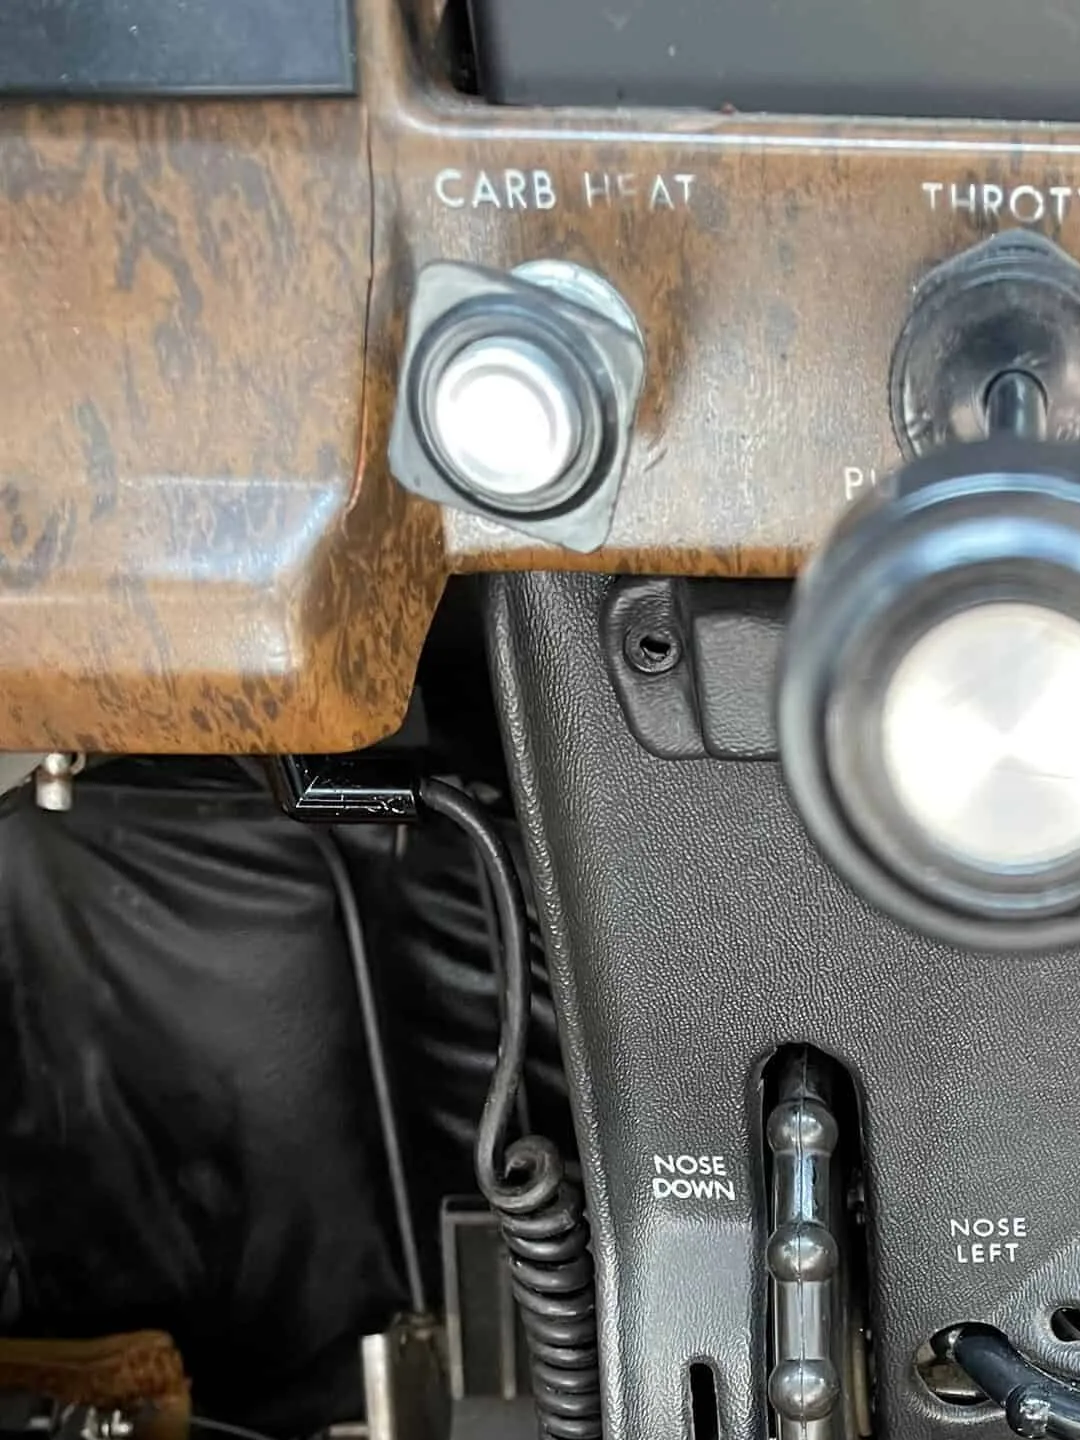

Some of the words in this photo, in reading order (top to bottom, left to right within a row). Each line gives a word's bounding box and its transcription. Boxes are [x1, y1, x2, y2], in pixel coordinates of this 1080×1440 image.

[434, 168, 556, 210] CARB
[584, 171, 697, 211] HEAT
[653, 1154, 727, 1176] NOSE
[652, 1178, 735, 1200] DOWN
[950, 1217, 1027, 1237] NOSE
[957, 1243, 1019, 1263] LEFT
